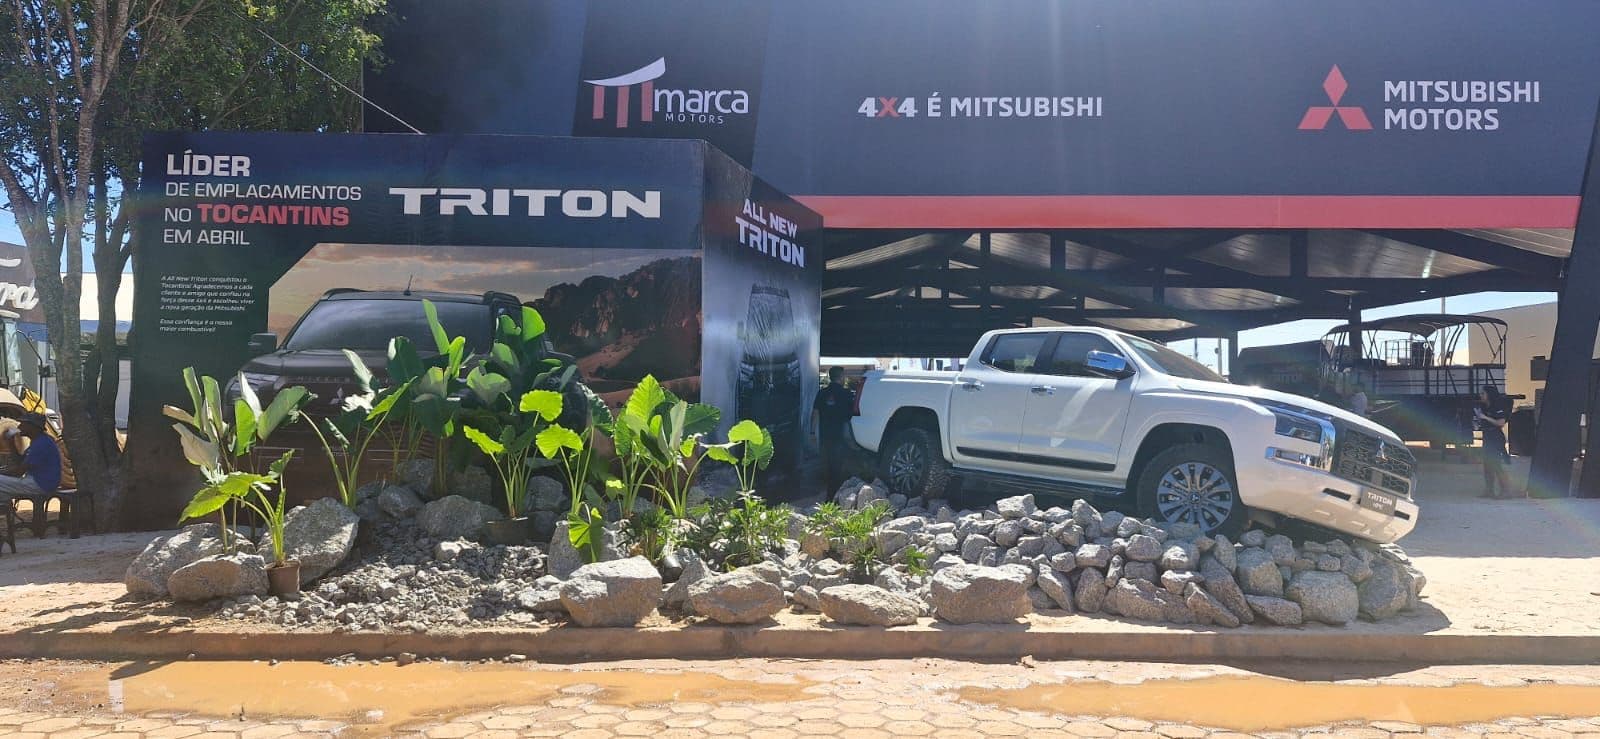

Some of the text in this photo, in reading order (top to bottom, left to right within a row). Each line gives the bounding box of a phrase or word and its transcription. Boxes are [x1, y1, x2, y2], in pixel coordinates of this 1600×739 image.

[654, 87, 749, 115] marca
[1384, 80, 1540, 103] MITSUBISHI
[927, 92, 942, 118] É
[950, 97, 1102, 118] MITSUBISHI
[665, 113, 724, 125] MOTORS
[1384, 108, 1499, 131] MOTORS
[166, 150, 250, 177] LÍDER
[165, 182, 362, 201] DE EMPLACAMENTOS
[389, 187, 661, 219] TRITON
[164, 203, 350, 226] NO TOCANTINS
[742, 198, 798, 239] ALL NEW
[163, 229, 250, 245] EM ABRIL
[735, 216, 805, 268] TRITON
[1367, 491, 1393, 506] TRITON
